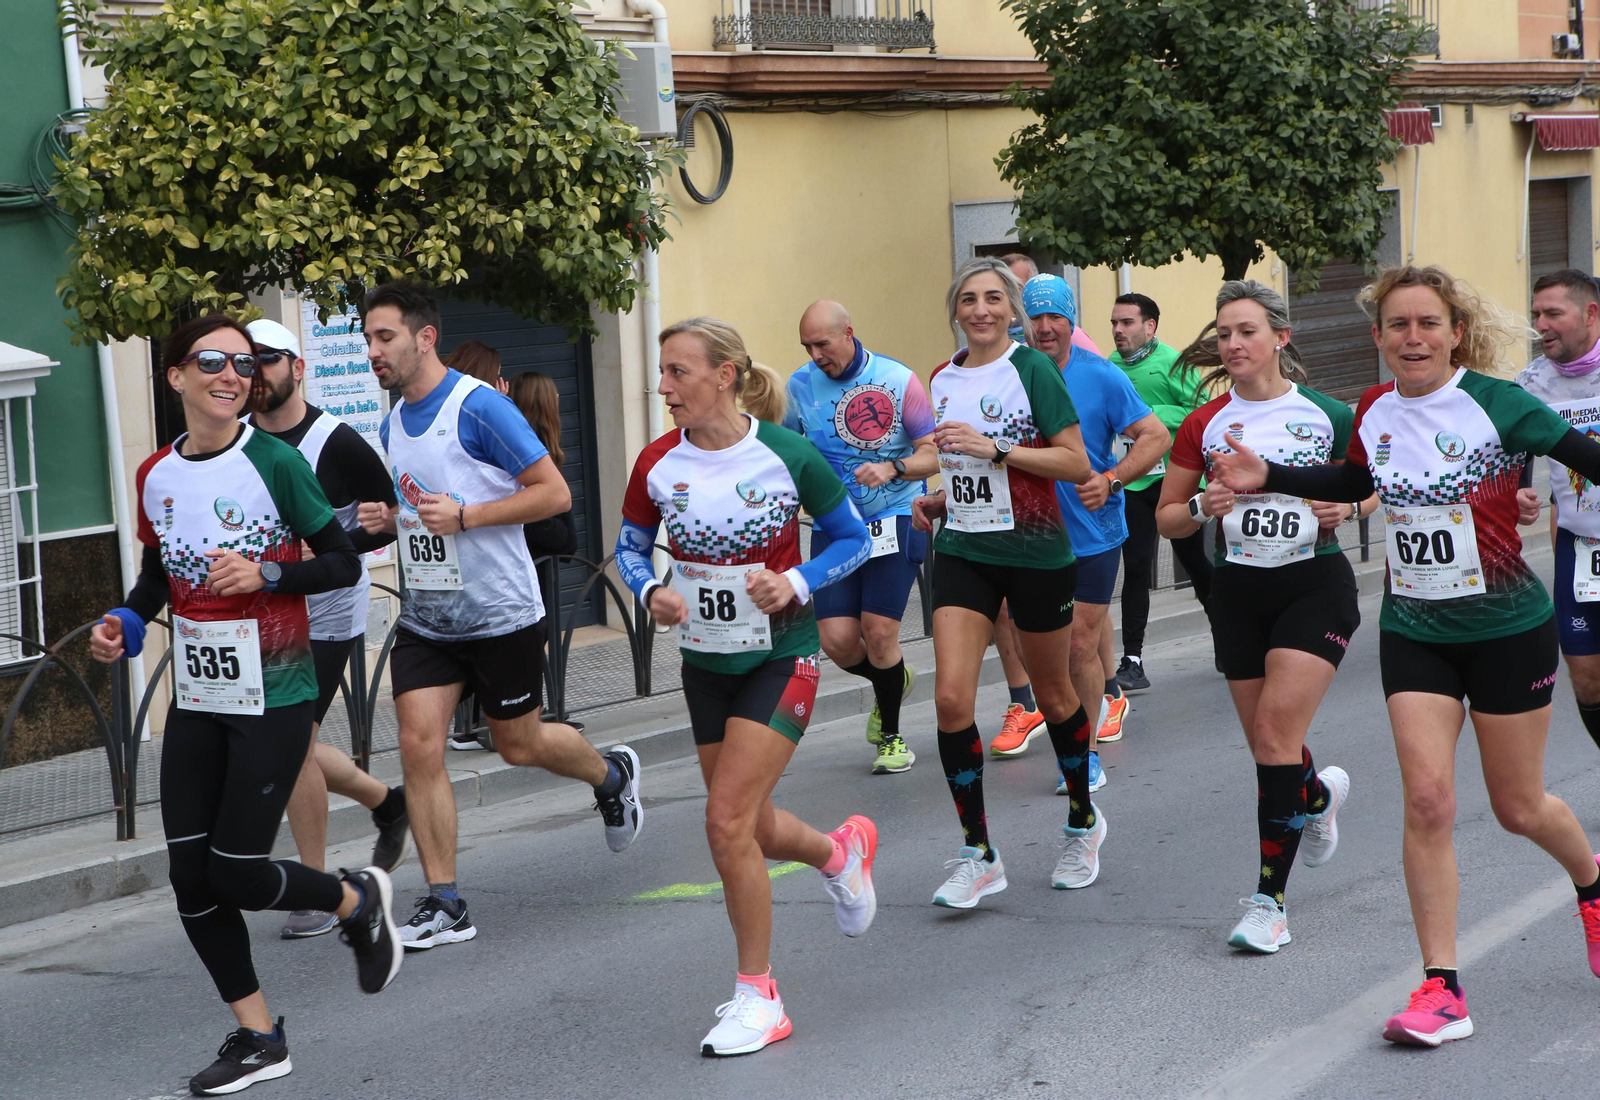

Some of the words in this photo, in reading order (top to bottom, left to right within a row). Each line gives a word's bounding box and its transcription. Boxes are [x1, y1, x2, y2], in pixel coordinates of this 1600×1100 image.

[315, 363, 346, 378] Diseño
[347, 360, 370, 374] floral
[321, 382, 365, 397] Pirotecnia
[343, 402, 355, 415] de
[356, 399, 379, 412] helio
[1573, 407, 1598, 418] MEDIA
[952, 475, 993, 504] 634
[1241, 508, 1301, 539] 636
[408, 534, 446, 562] 639
[1395, 529, 1455, 565] 620
[699, 587, 737, 622] 58
[185, 644, 240, 680] 535
